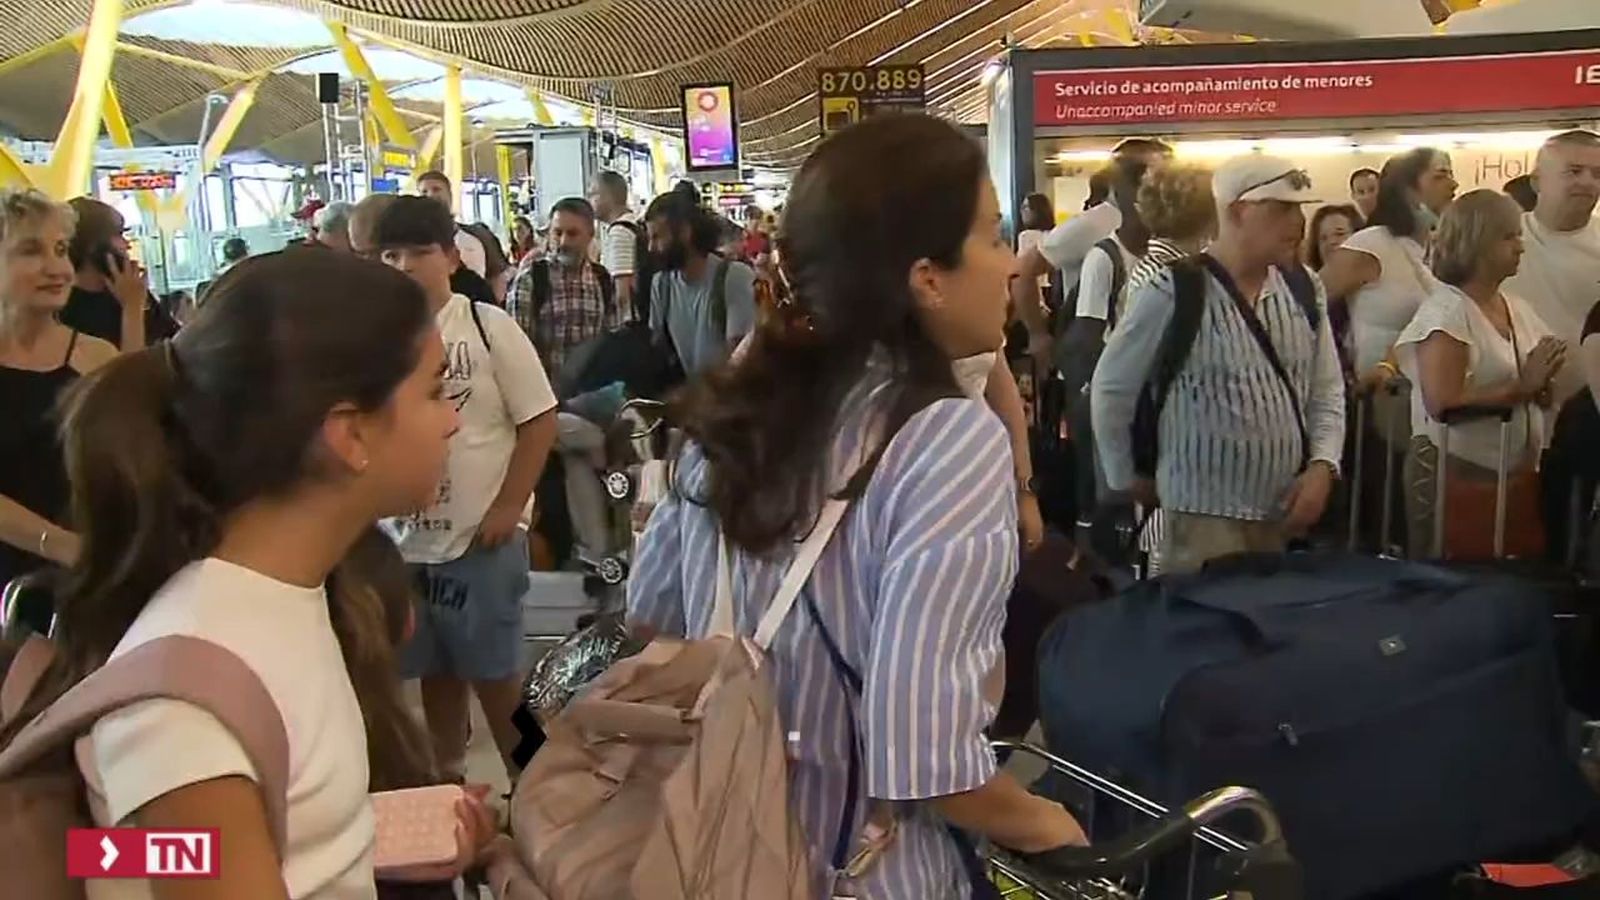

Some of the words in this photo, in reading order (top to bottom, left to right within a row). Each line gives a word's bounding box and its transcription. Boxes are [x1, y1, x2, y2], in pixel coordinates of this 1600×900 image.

[1055, 81, 1118, 96] Servicio
[1120, 80, 1140, 94] de
[1142, 76, 1279, 94] acompañamiento
[1281, 75, 1301, 89] de
[1304, 75, 1373, 88] menores
[1055, 101, 1176, 119] Unaccompanied
[1178, 101, 1222, 114] minor
[1224, 97, 1277, 113] service
